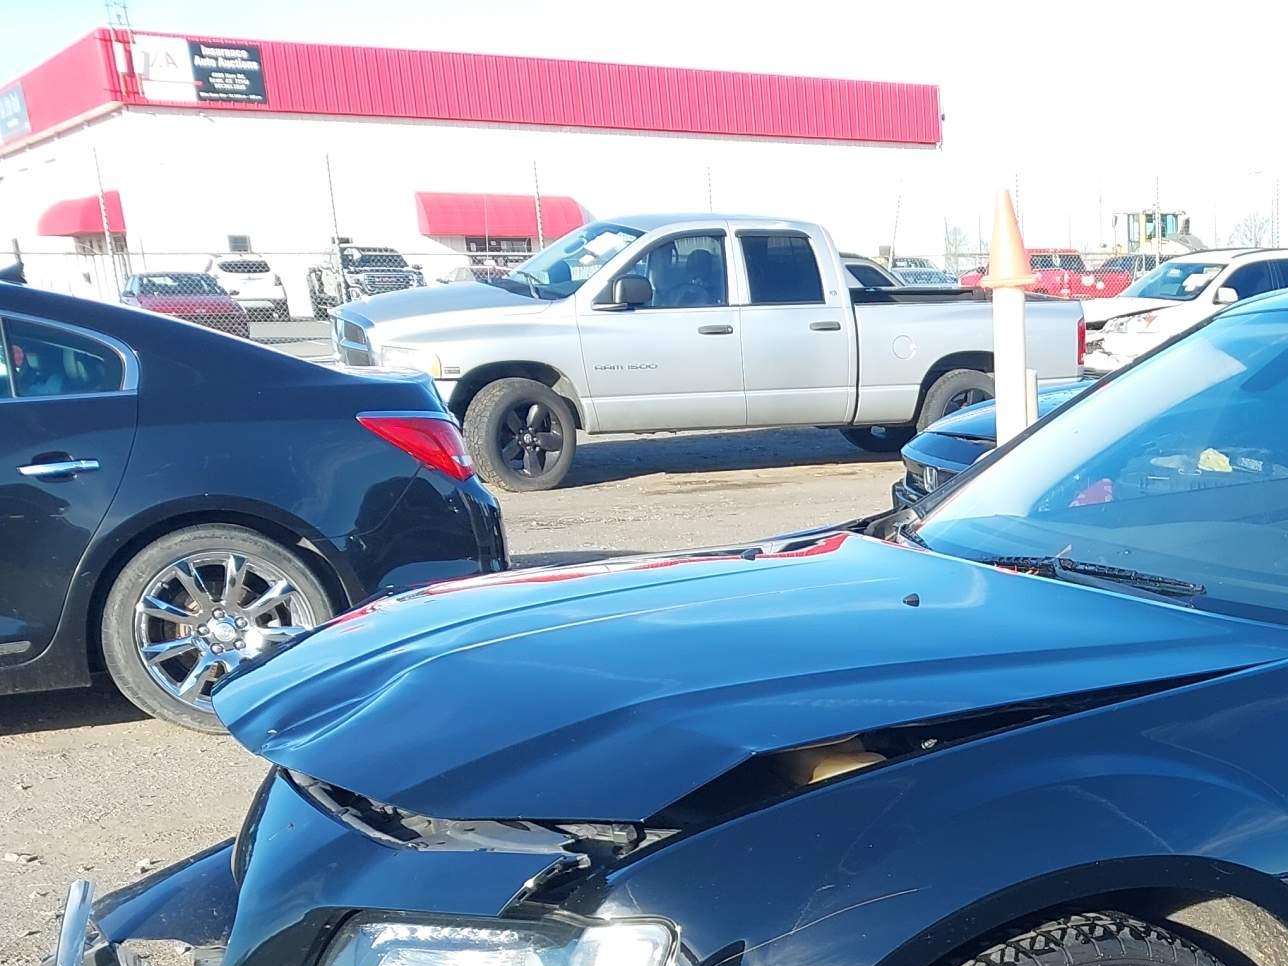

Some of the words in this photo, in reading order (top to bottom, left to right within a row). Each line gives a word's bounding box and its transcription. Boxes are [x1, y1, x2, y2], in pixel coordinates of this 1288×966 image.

[200, 44, 249, 59] Insurance
[193, 55, 217, 68] Auto
[217, 57, 260, 71] Auctions
